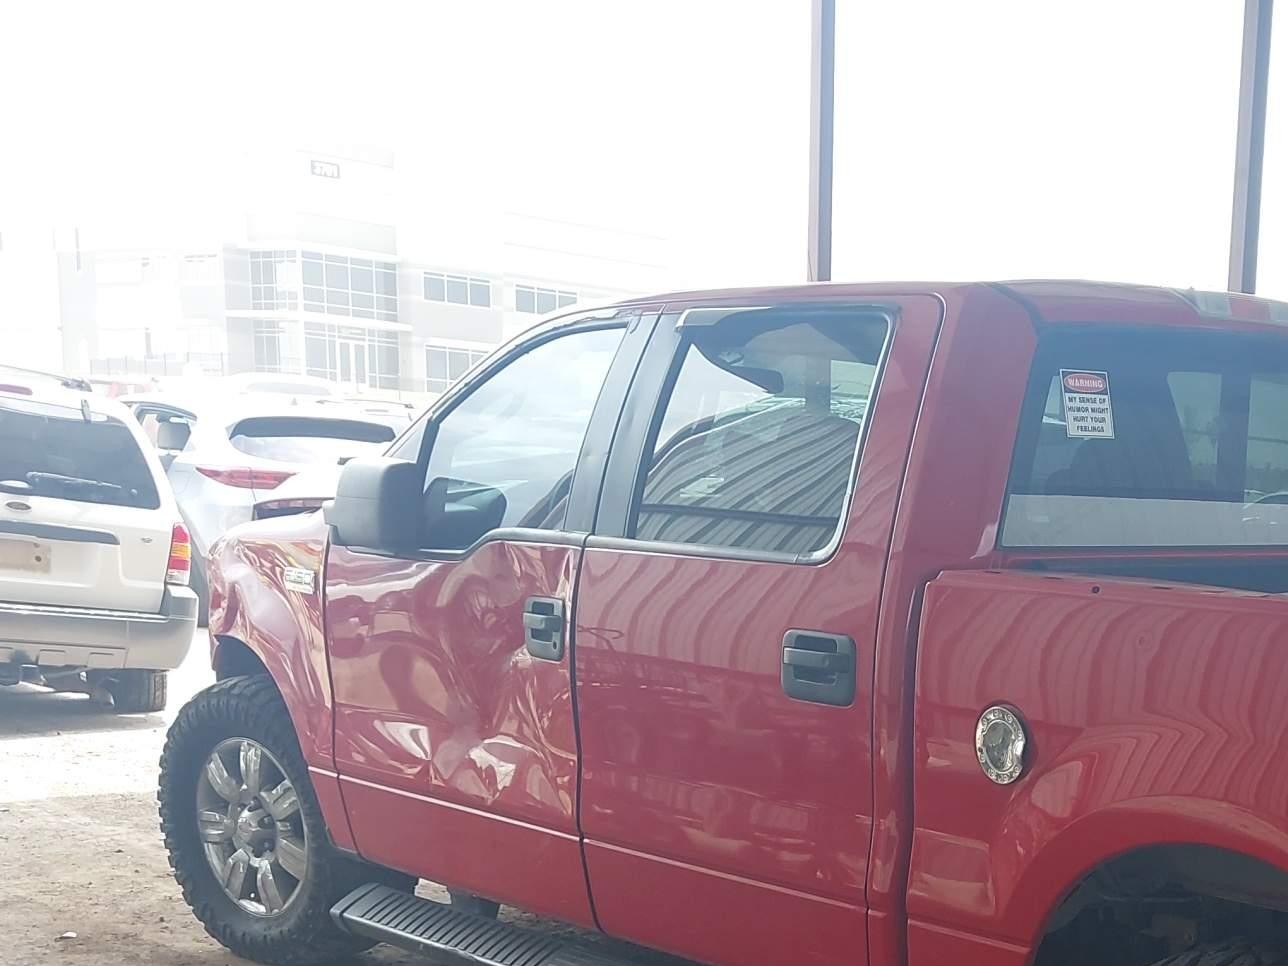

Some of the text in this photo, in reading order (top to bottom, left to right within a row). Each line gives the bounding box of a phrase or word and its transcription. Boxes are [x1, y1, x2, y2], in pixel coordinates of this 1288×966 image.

[1067, 378, 1103, 388] WARNING
[1078, 396, 1097, 404] SENSE
[1090, 416, 1107, 424] YOUR
[1077, 425, 1105, 433] FEELINGS
